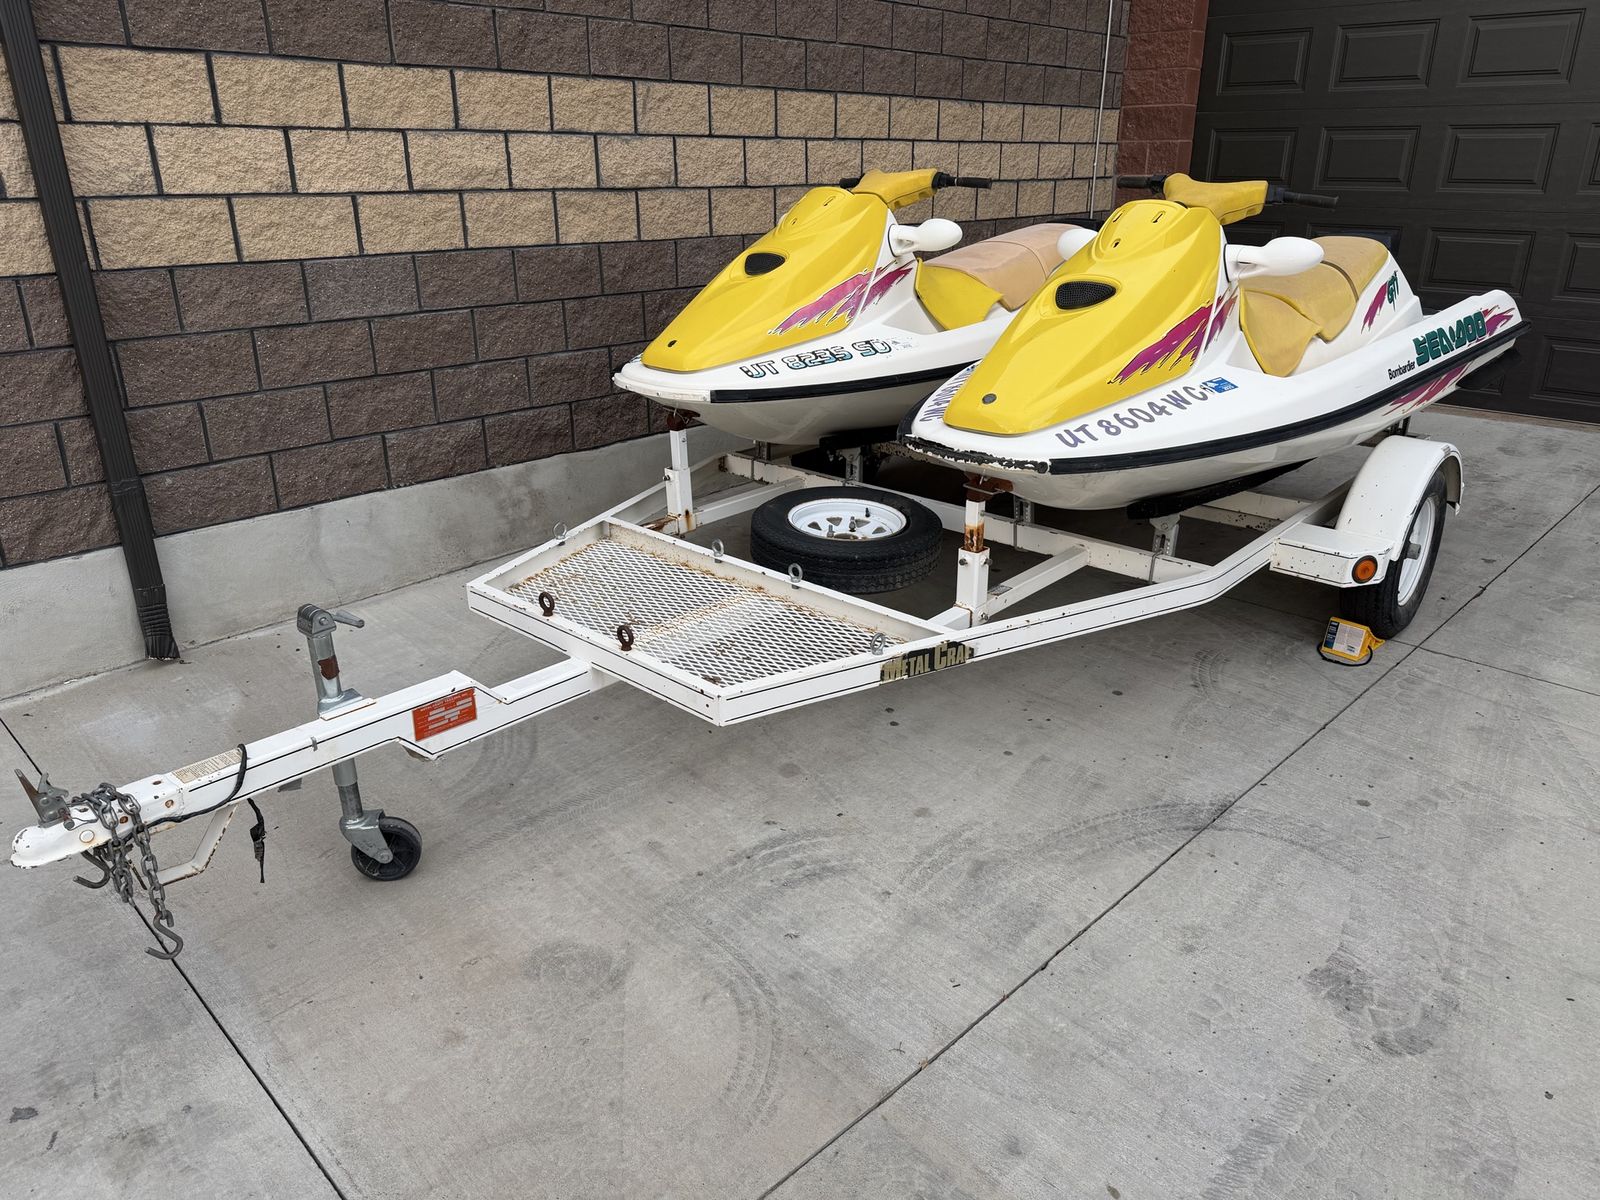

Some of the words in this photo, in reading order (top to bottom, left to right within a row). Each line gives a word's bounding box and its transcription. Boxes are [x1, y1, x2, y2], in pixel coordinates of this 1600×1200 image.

[740, 359, 780, 378] UT
[1388, 360, 1416, 380] Bombardier
[1055, 424, 1099, 448] UT
[882, 653, 931, 681] METAL
